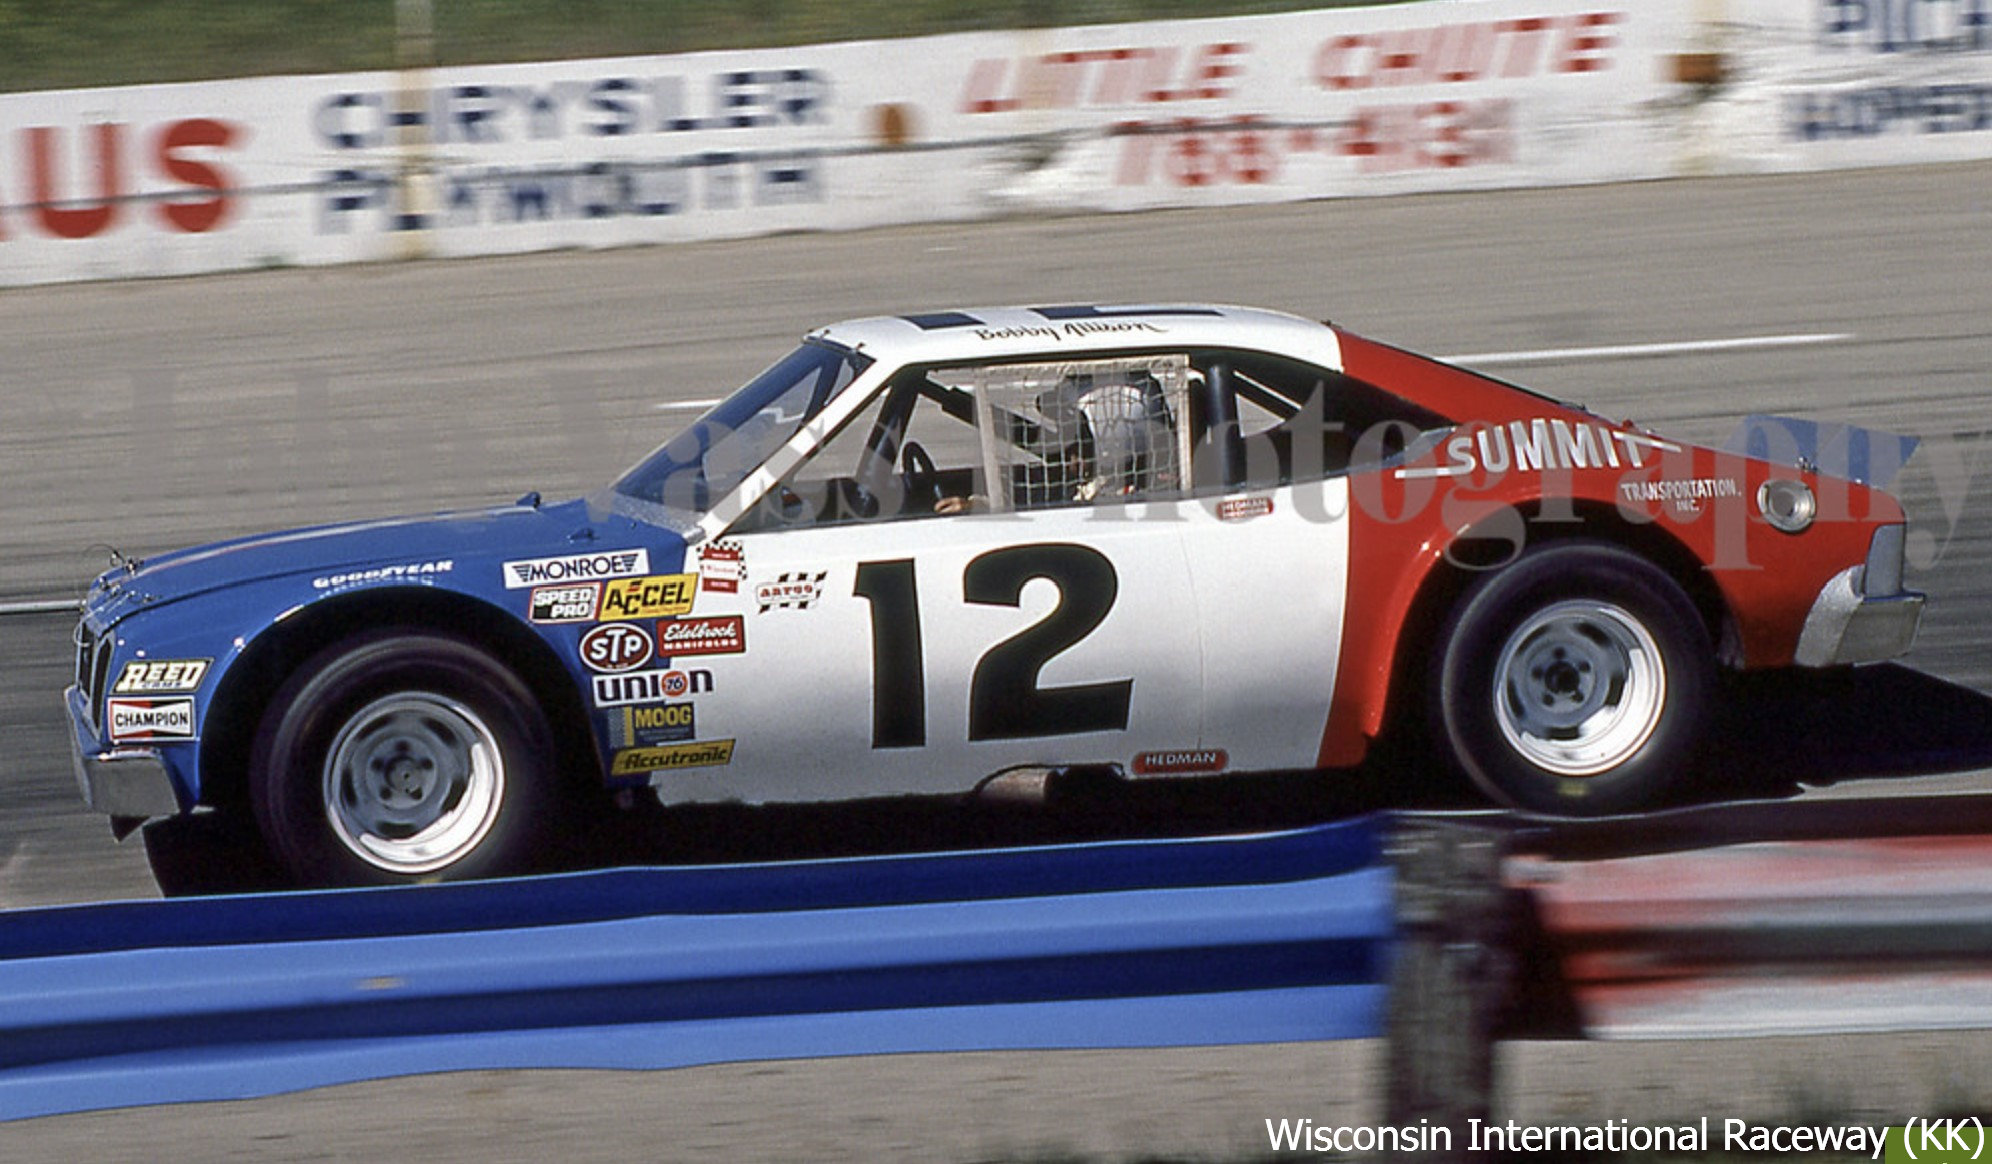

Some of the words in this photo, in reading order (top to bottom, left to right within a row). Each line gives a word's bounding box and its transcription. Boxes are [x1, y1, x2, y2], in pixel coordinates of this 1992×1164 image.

[312, 68, 831, 150] CHRYSLER
[0, 117, 248, 243] US
[314, 150, 827, 236] PLYMOUTH
[975, 325, 1061, 342] Bobby
[1395, 417, 1682, 478] SUMMIT
[313, 560, 453, 588] GOODYEAR
[530, 555, 625, 581] MONROE
[533, 587, 592, 606] SPEED
[605, 580, 690, 615] ACCEL
[551, 603, 589, 618] PRO
[664, 621, 737, 641] Edelbrock
[589, 628, 643, 662] STP
[852, 541, 1135, 750] 12
[115, 661, 207, 692] REED
[666, 676, 684, 691] 76
[115, 711, 188, 728] CHAMPION
[635, 704, 693, 729] MOOG
[624, 747, 728, 770] Accutronic
[1145, 751, 1216, 766] HEDMAN
